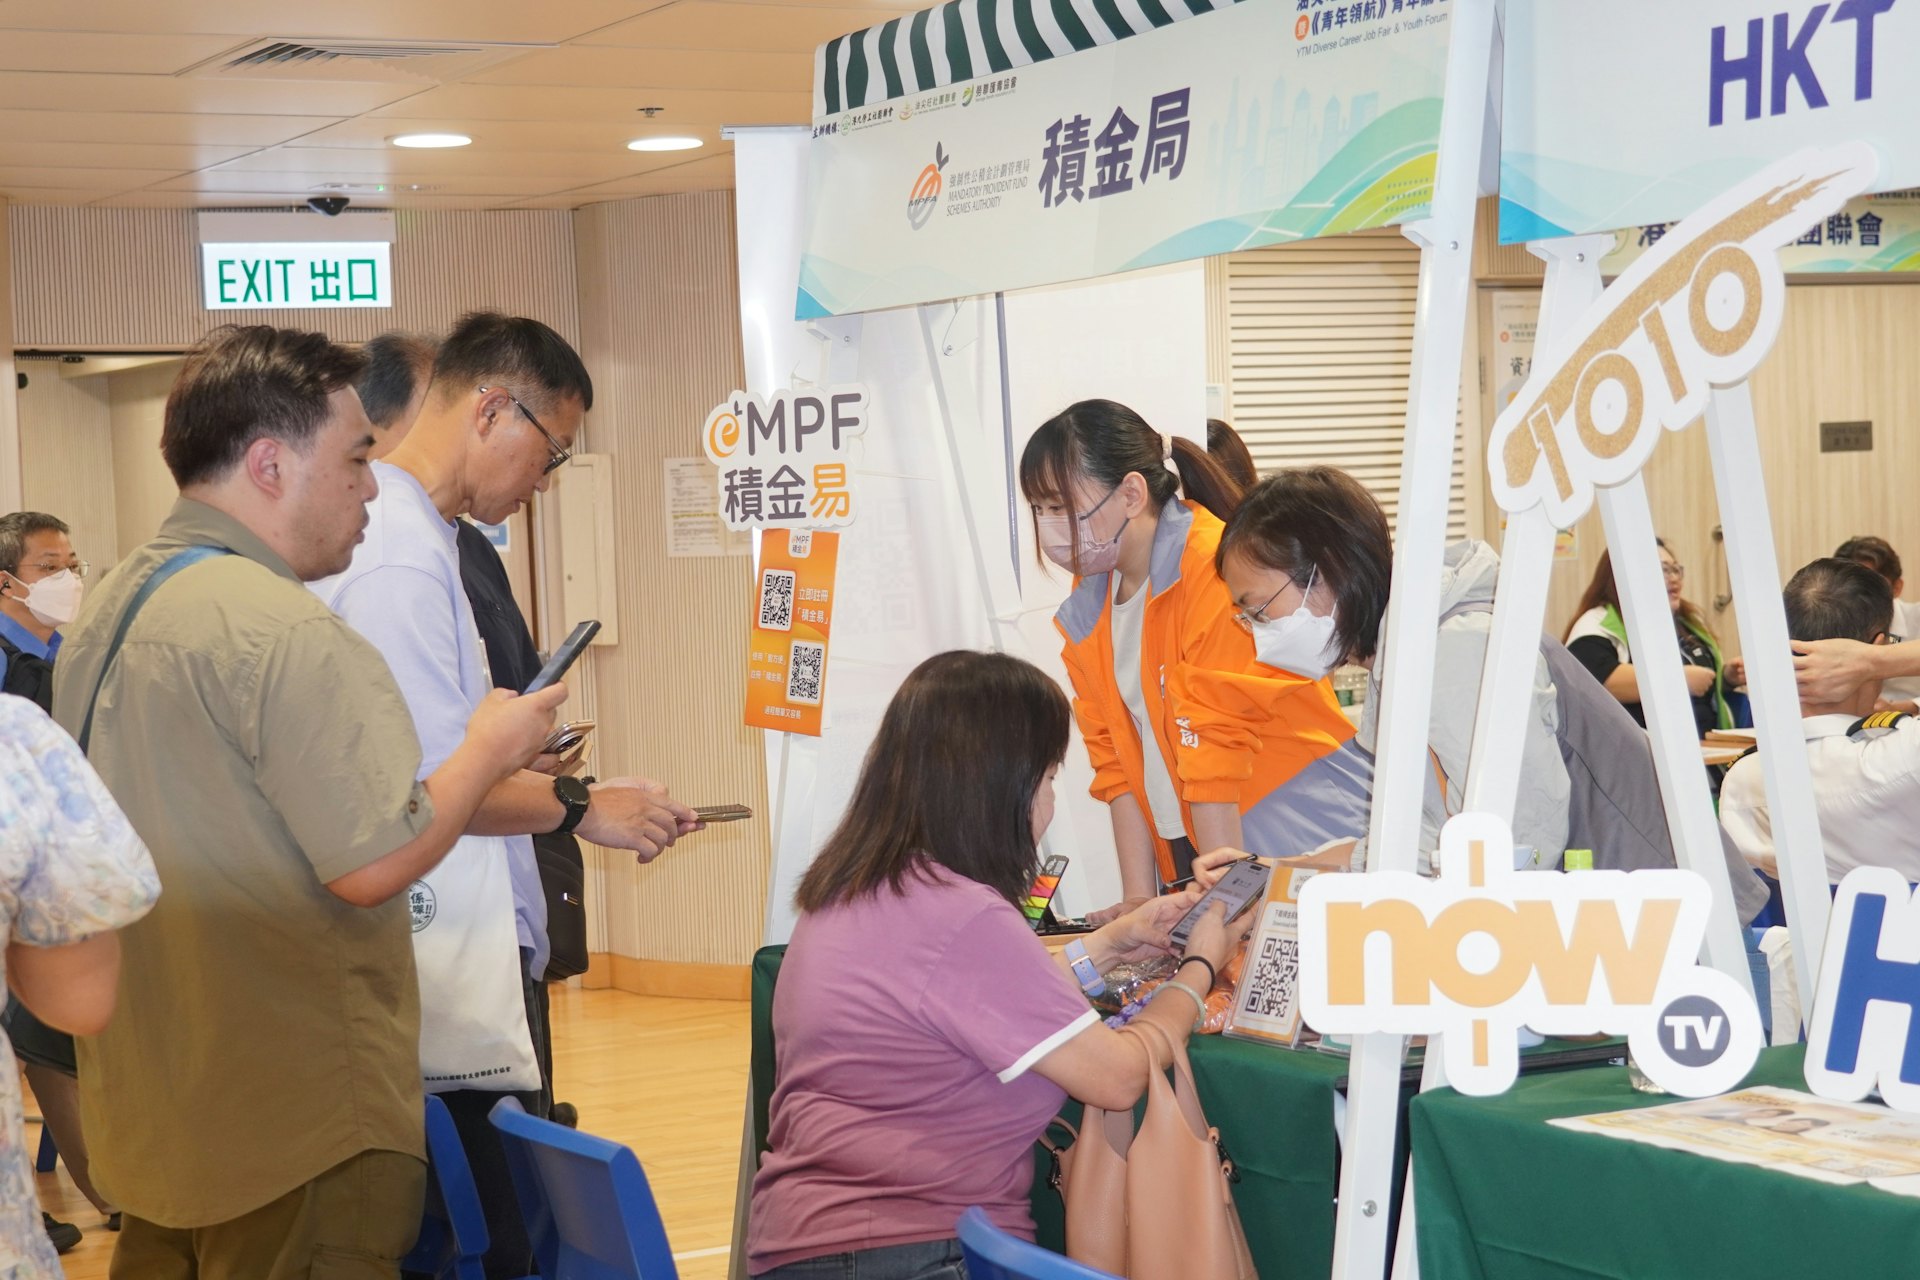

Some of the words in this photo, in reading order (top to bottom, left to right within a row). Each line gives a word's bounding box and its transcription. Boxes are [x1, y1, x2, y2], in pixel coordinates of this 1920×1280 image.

[1296, 46, 1312, 58] YTM
[1313, 40, 1338, 55] Diverse
[1339, 34, 1362, 48] Career
[1363, 30, 1377, 42] Job
[1378, 26, 1391, 37] Fair
[1394, 23, 1400, 34] &
[1403, 18, 1424, 31] Youth
[1425, 12, 1448, 27] Forum
[1709, 0, 1896, 127] HKT
[1039, 86, 1192, 208] 積金局
[908, 196, 938, 207] MPFA
[946, 200, 972, 216] SCHEMES
[972, 196, 1001, 212] AUTHORITY
[948, 184, 982, 202] MANDATORY
[982, 179, 1013, 196] PROVIDENT
[1013, 176, 1029, 191] FUND
[218, 259, 296, 303] EXIT
[311, 259, 378, 301] 出口
[1529, 245, 1763, 504] 1010
[709, 392, 862, 458] eMPF
[724, 463, 851, 524] 積金易
[1326, 897, 1682, 1006] now
[1664, 1015, 1722, 1050] TV
